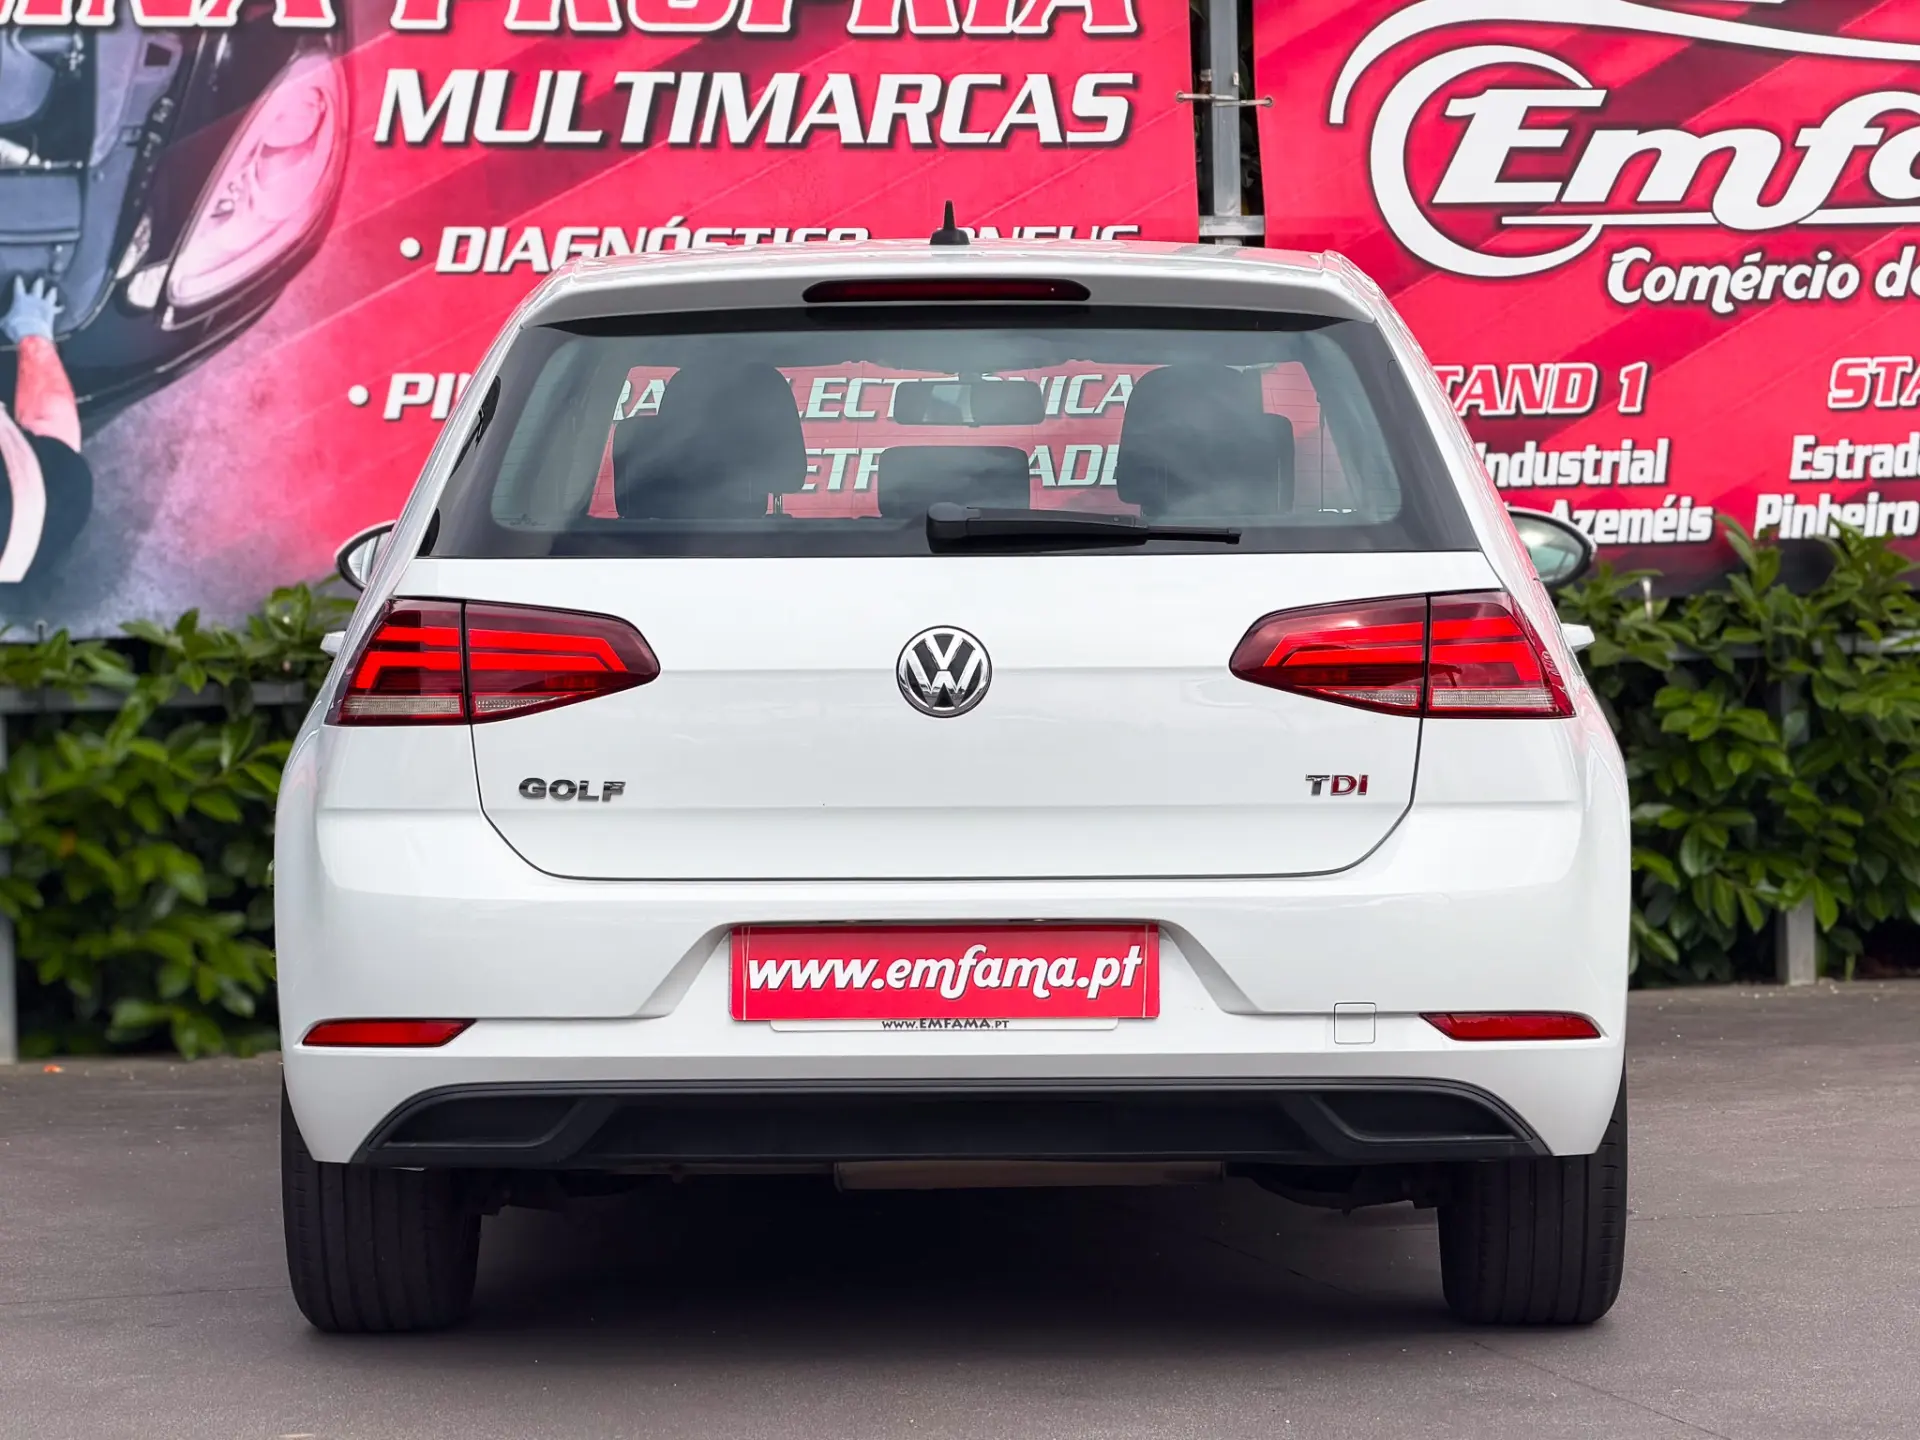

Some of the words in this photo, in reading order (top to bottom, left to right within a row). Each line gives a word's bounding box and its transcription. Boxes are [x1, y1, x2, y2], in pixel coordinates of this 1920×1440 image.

[374, 68, 1134, 144] MULTIMARCAS
[435, 215, 868, 273] DIAGNÓ
[1607, 246, 1860, 314] Comércio
[1875, 245, 1920, 299] d
[1430, 362, 1598, 416] TAND
[1617, 361, 1648, 413] 1
[1789, 431, 1920, 480] Estrad
[1753, 491, 1919, 540] Pinheiro
[518, 777, 626, 802] GOLF
[1305, 774, 1369, 796] TDI
[748, 944, 1143, 999] www.emfama.pt
